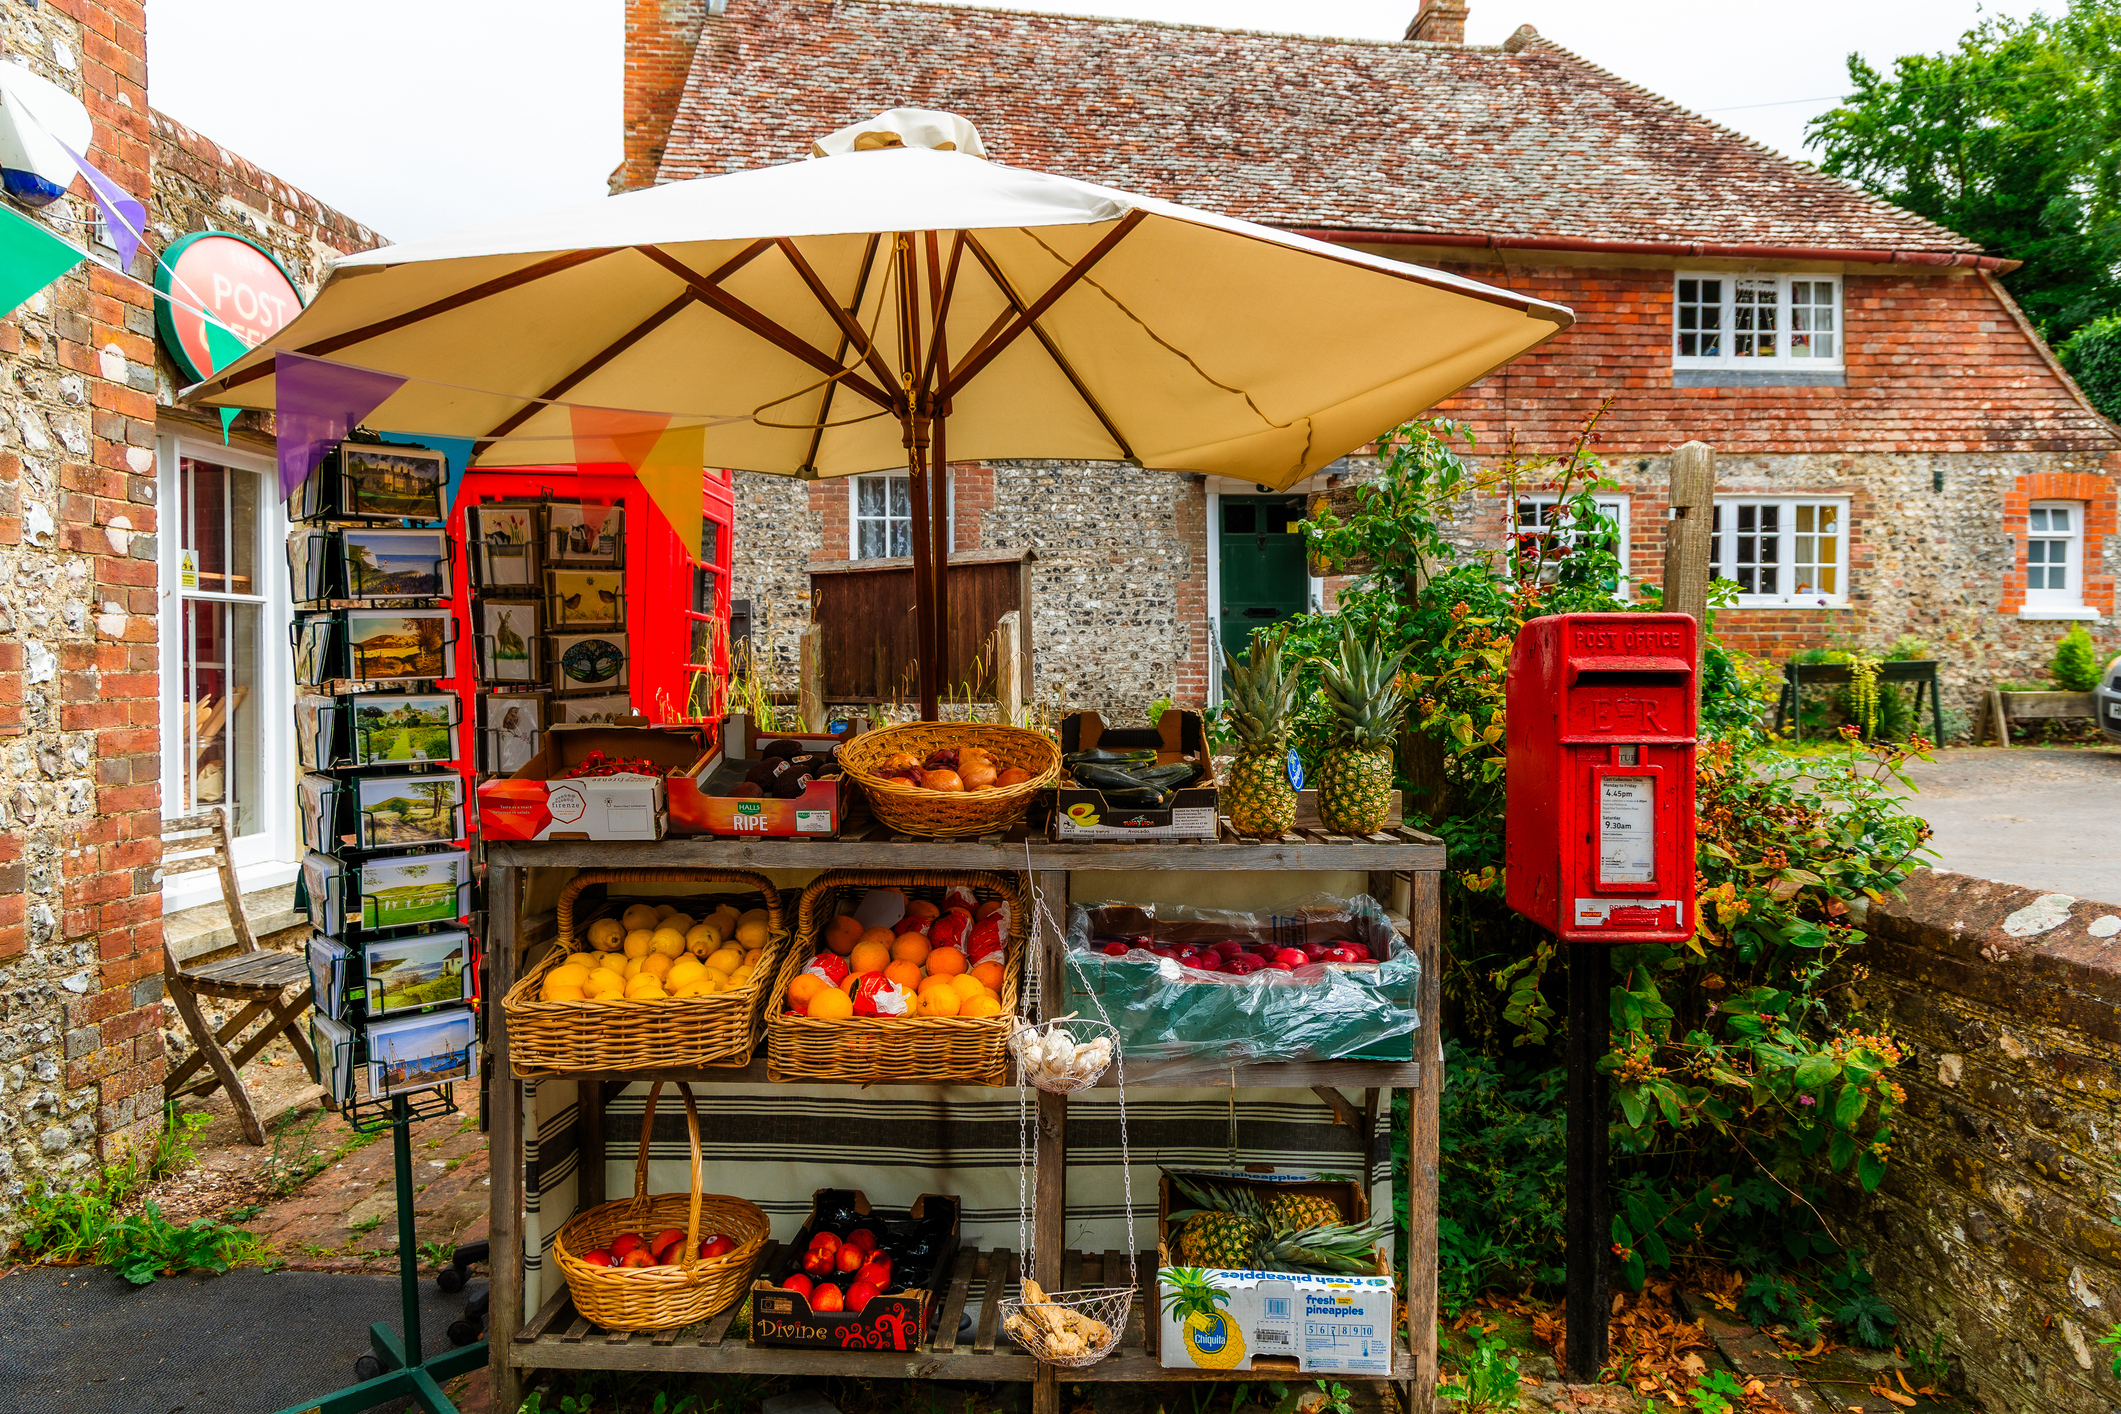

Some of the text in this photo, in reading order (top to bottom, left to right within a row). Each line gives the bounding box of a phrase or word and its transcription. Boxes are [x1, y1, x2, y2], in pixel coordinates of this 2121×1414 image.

[230, 250, 266, 277] FIRLE
[213, 272, 287, 330] POST
[1575, 631, 1680, 648] POST OFFICE
[1606, 789, 1632, 798] 4.45pm
[552, 801, 580, 809] firenze
[733, 815, 768, 831] RIPE
[1605, 821, 1631, 829] 9.30am
[1231, 1171, 1307, 1182] pineapples
[1220, 1271, 1312, 1283] pineapples
[1316, 1276, 1363, 1286] fresh
[1306, 1295, 1336, 1305] fresh
[1306, 1305, 1364, 1318] pineapples
[757, 1319, 828, 1340] Divine
[1308, 1325, 1372, 1336] 5 6 7 8 9 10
[1194, 1334, 1226, 1347] Chiquita
